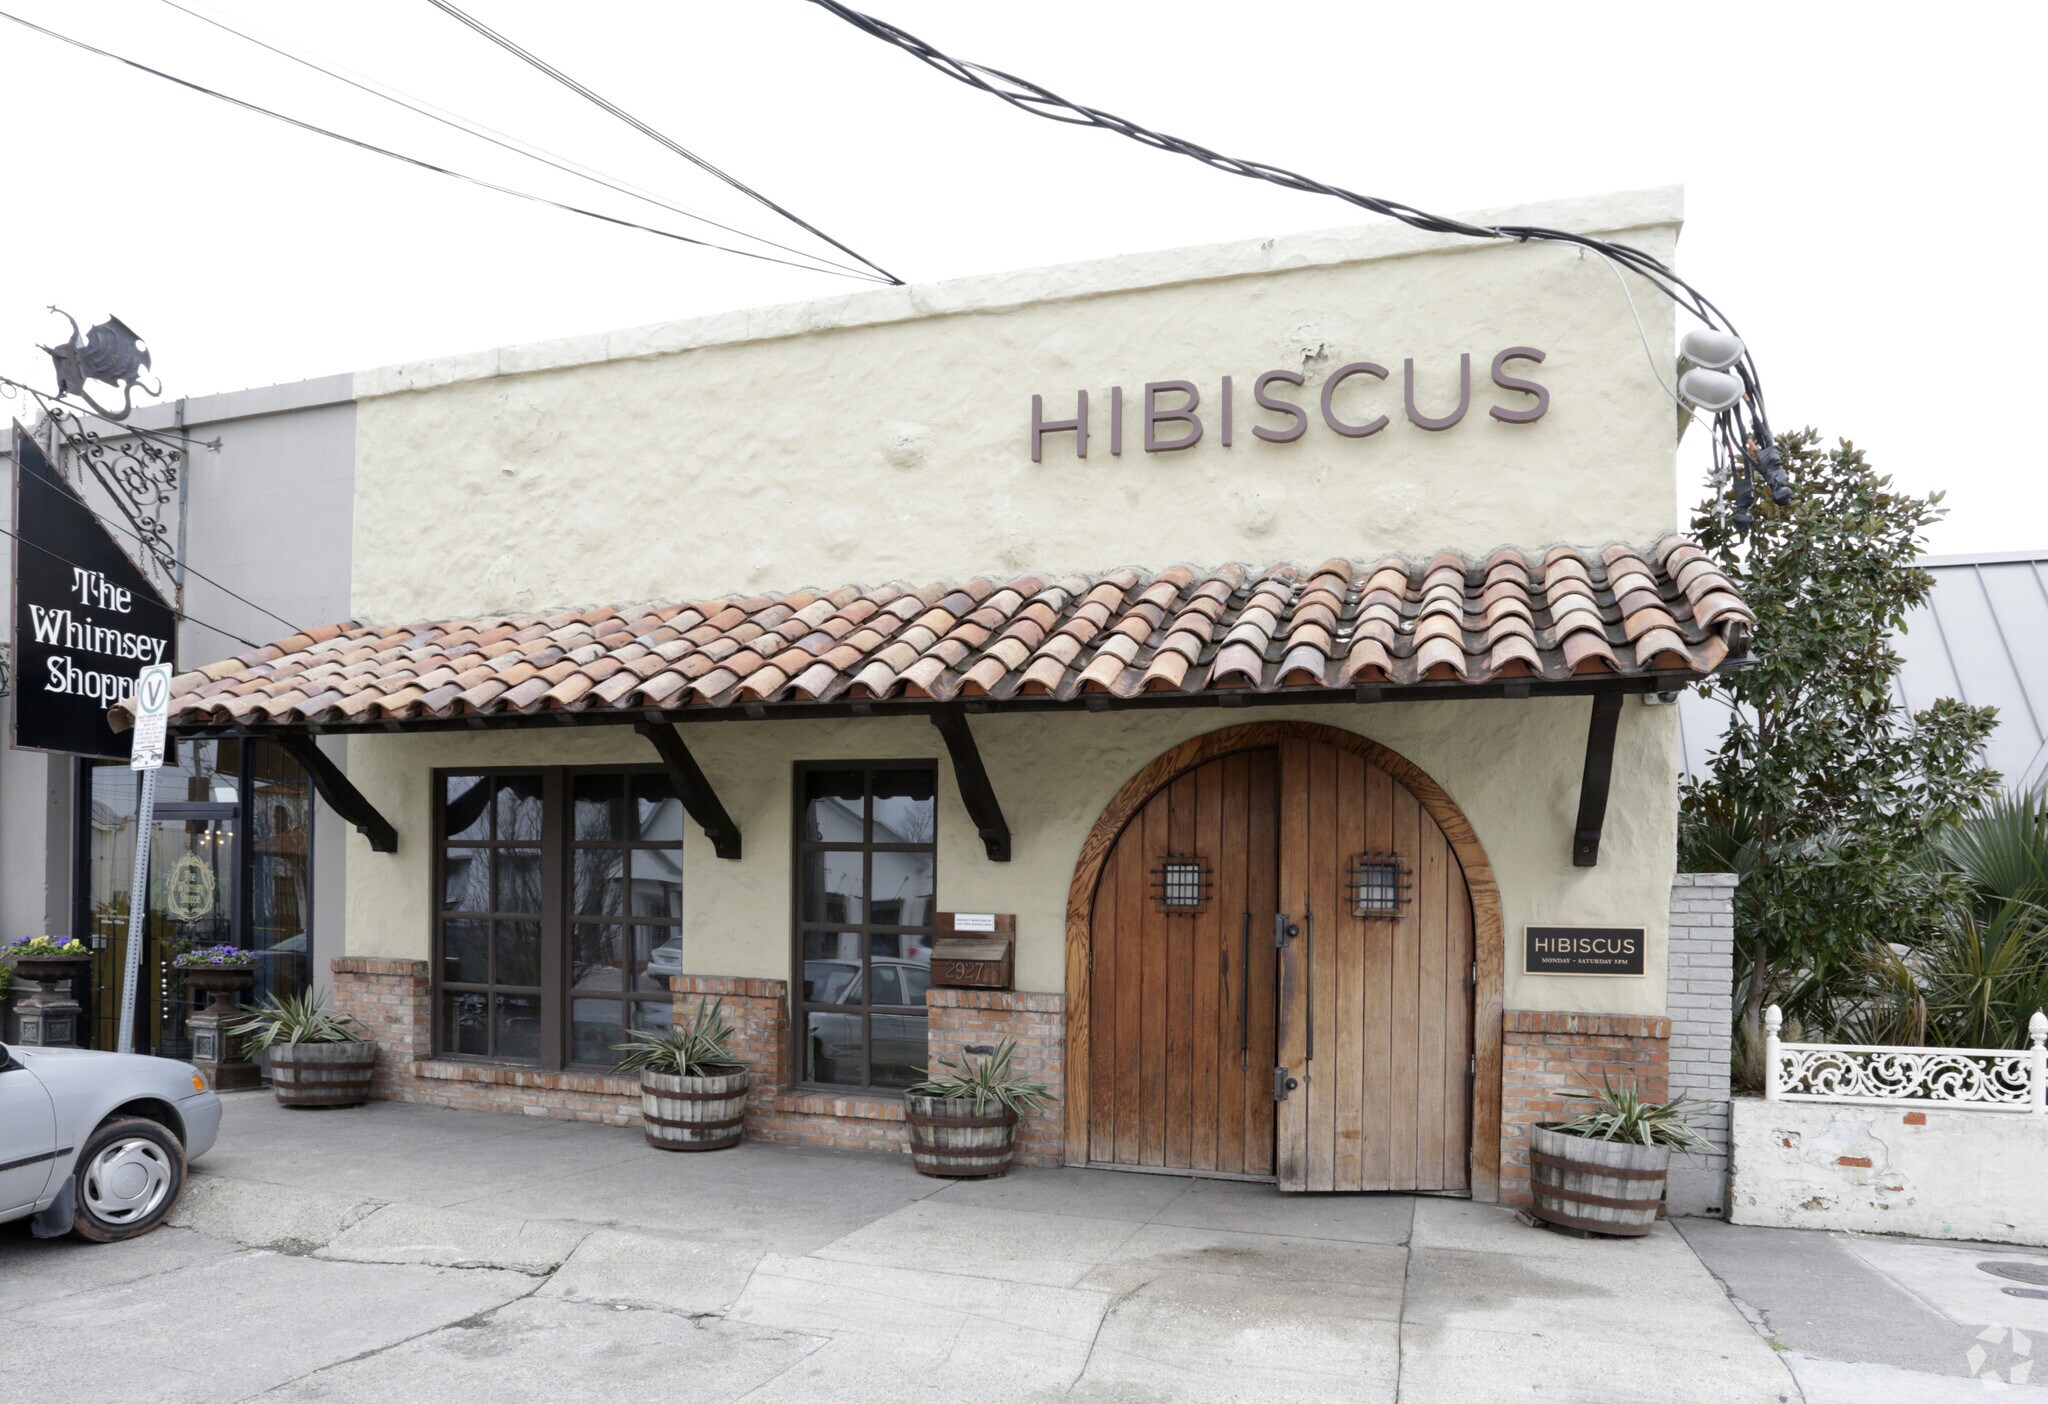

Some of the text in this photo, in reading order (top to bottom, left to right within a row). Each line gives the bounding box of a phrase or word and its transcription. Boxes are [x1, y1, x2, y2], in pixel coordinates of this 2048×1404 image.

[1031, 346, 1551, 463] HIBISCUS
[72, 567, 131, 613] The
[28, 604, 167, 664] Whimsey
[1535, 938, 1635, 954] HIBISCUS
[946, 962, 984, 980] 2927
